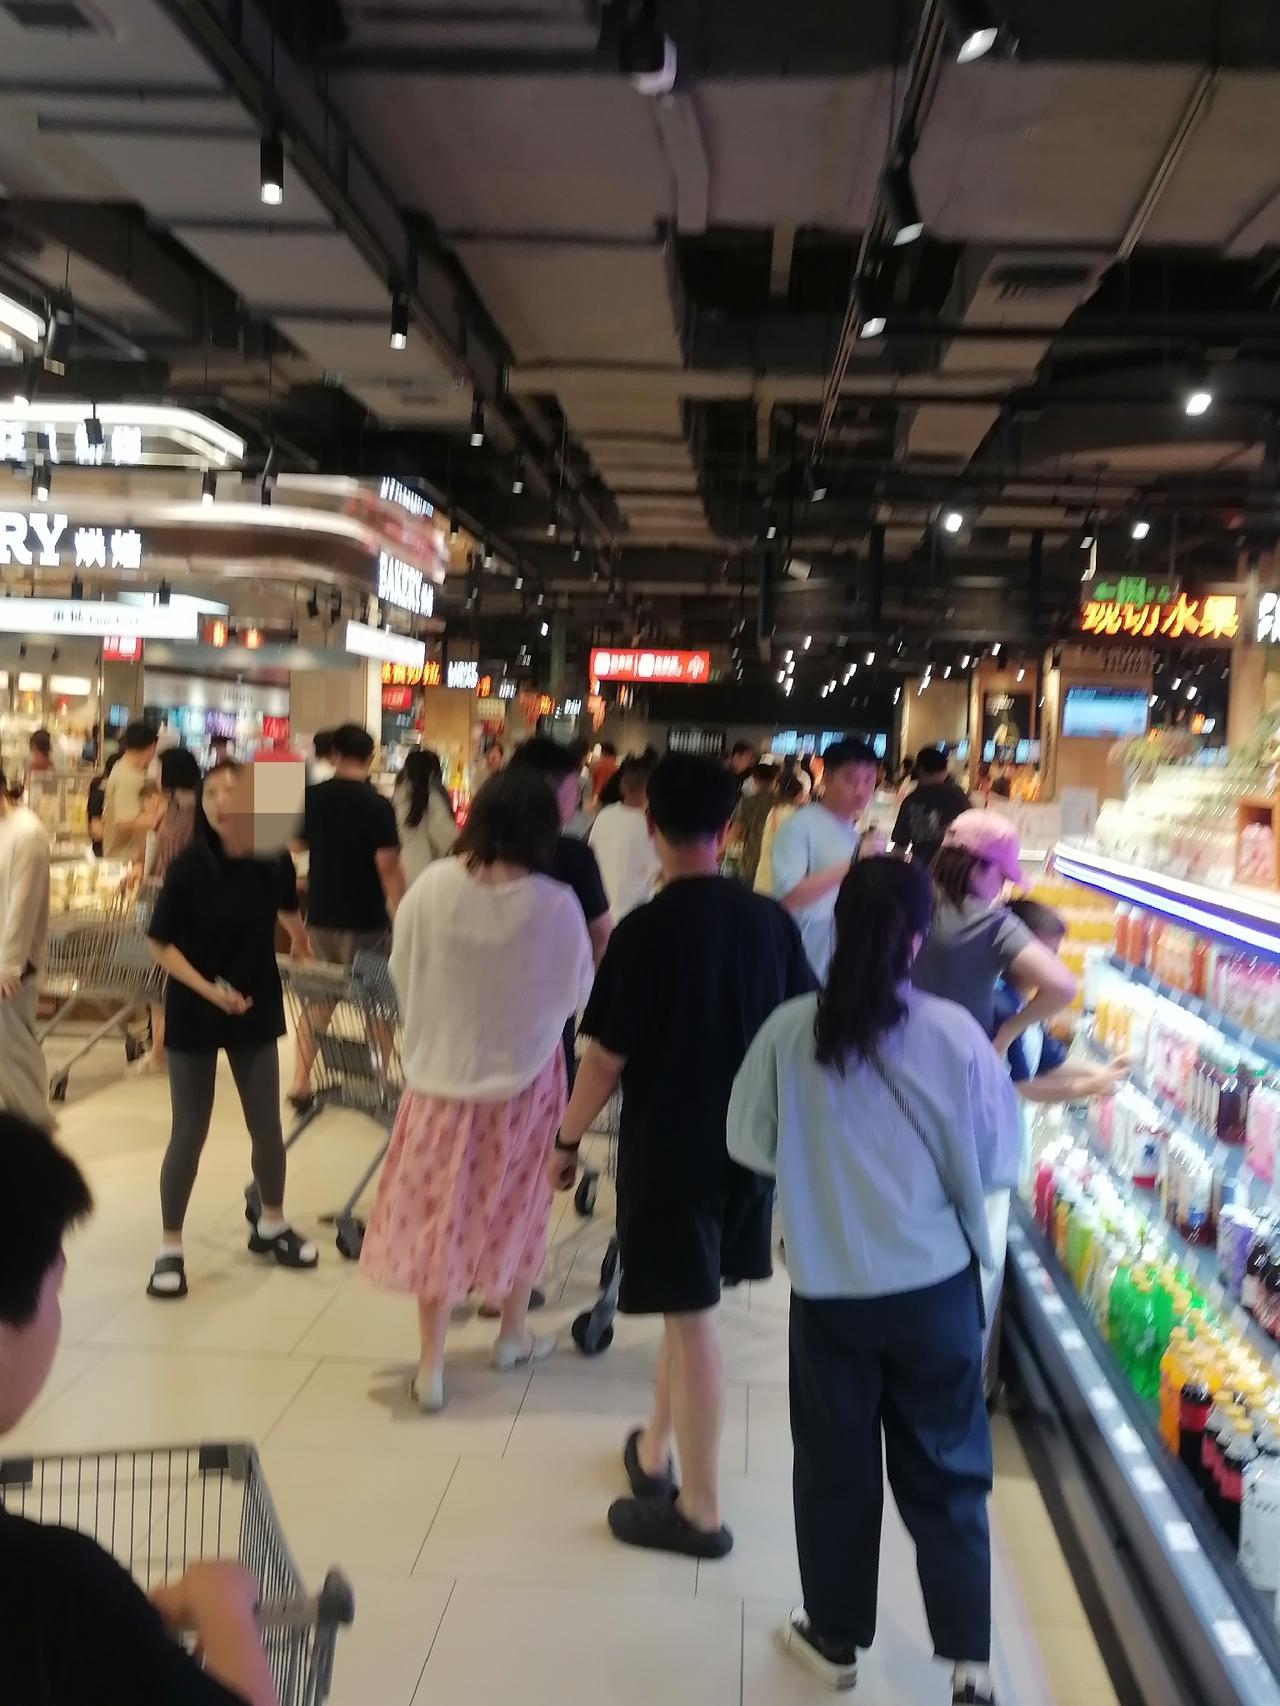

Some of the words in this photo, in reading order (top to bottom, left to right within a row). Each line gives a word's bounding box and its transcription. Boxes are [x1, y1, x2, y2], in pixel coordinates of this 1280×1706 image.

[0, 512, 68, 566] RY
[1081, 592, 1239, 639] 现切水果
